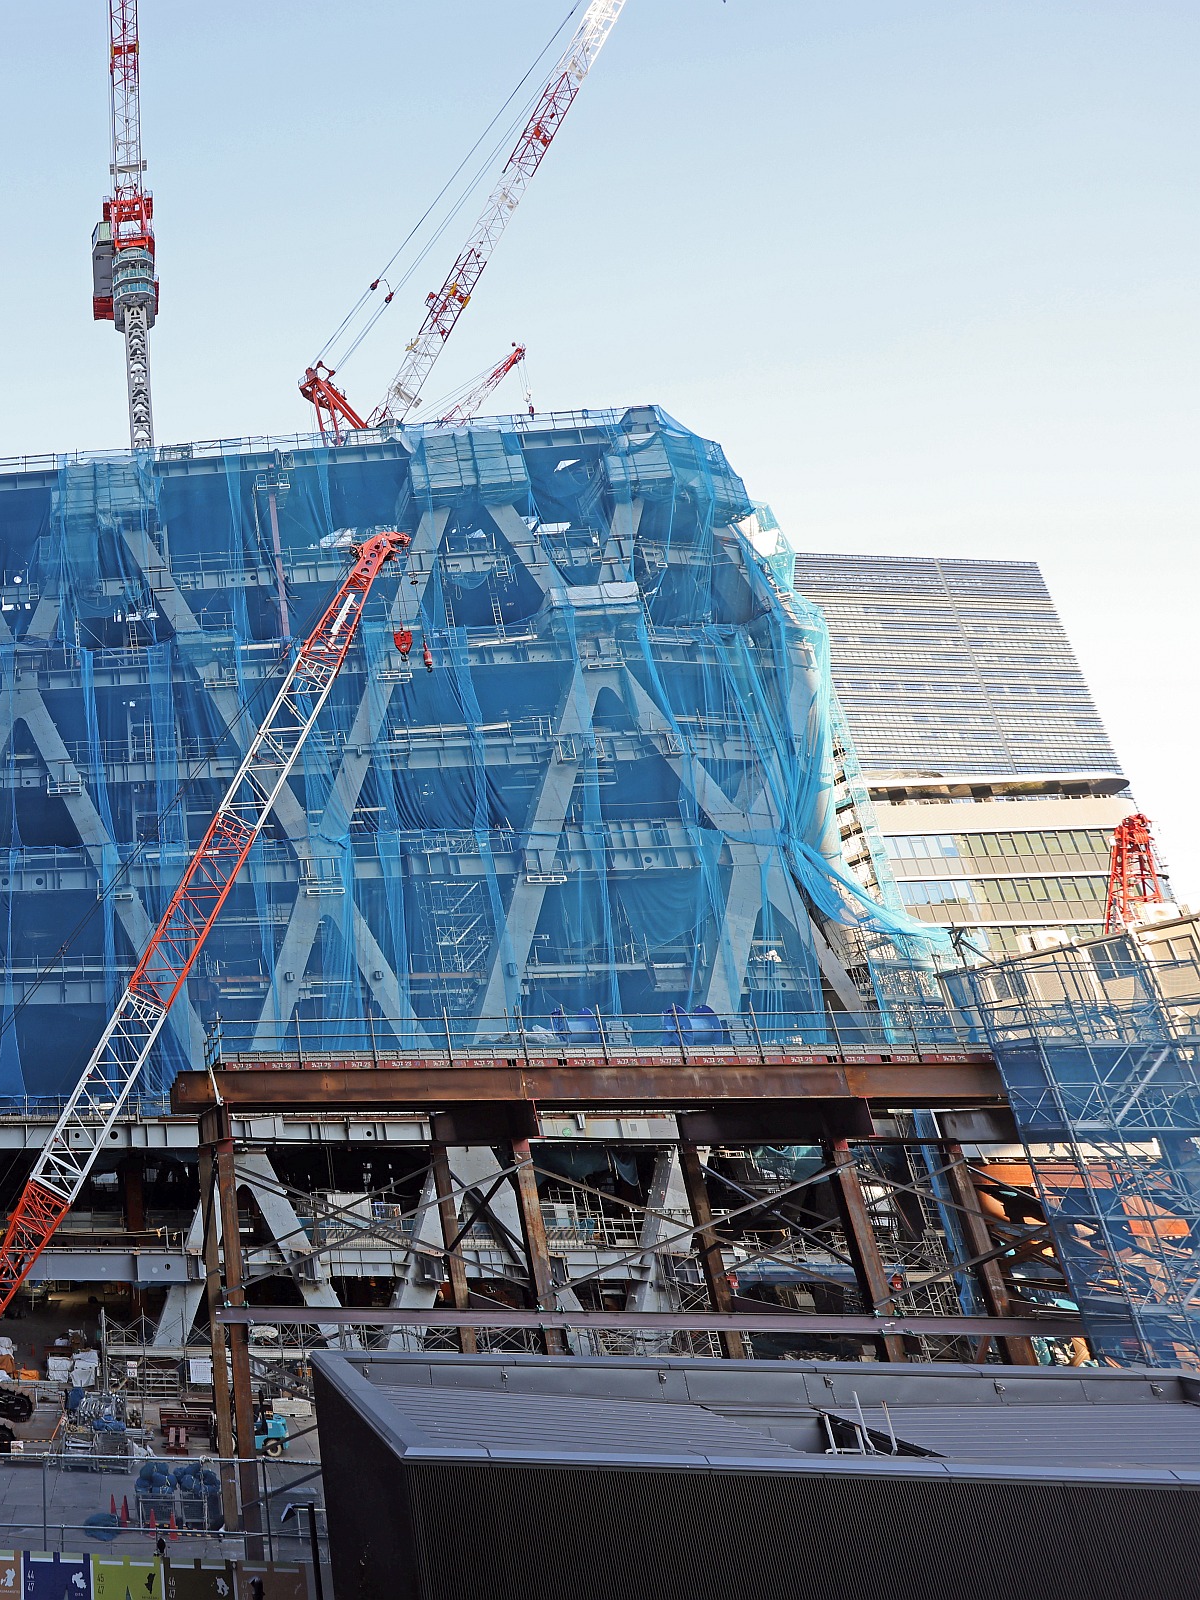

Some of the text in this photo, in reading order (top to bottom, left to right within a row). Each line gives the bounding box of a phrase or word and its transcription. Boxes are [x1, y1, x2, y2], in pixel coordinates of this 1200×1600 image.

[27, 1570, 34, 1579] 44
[97, 1574, 104, 1582] 45
[168, 1577, 175, 1586] 46
[27, 1583, 34, 1592] 47
[97, 1586, 104, 1595] 47
[169, 1590, 175, 1599] 47
